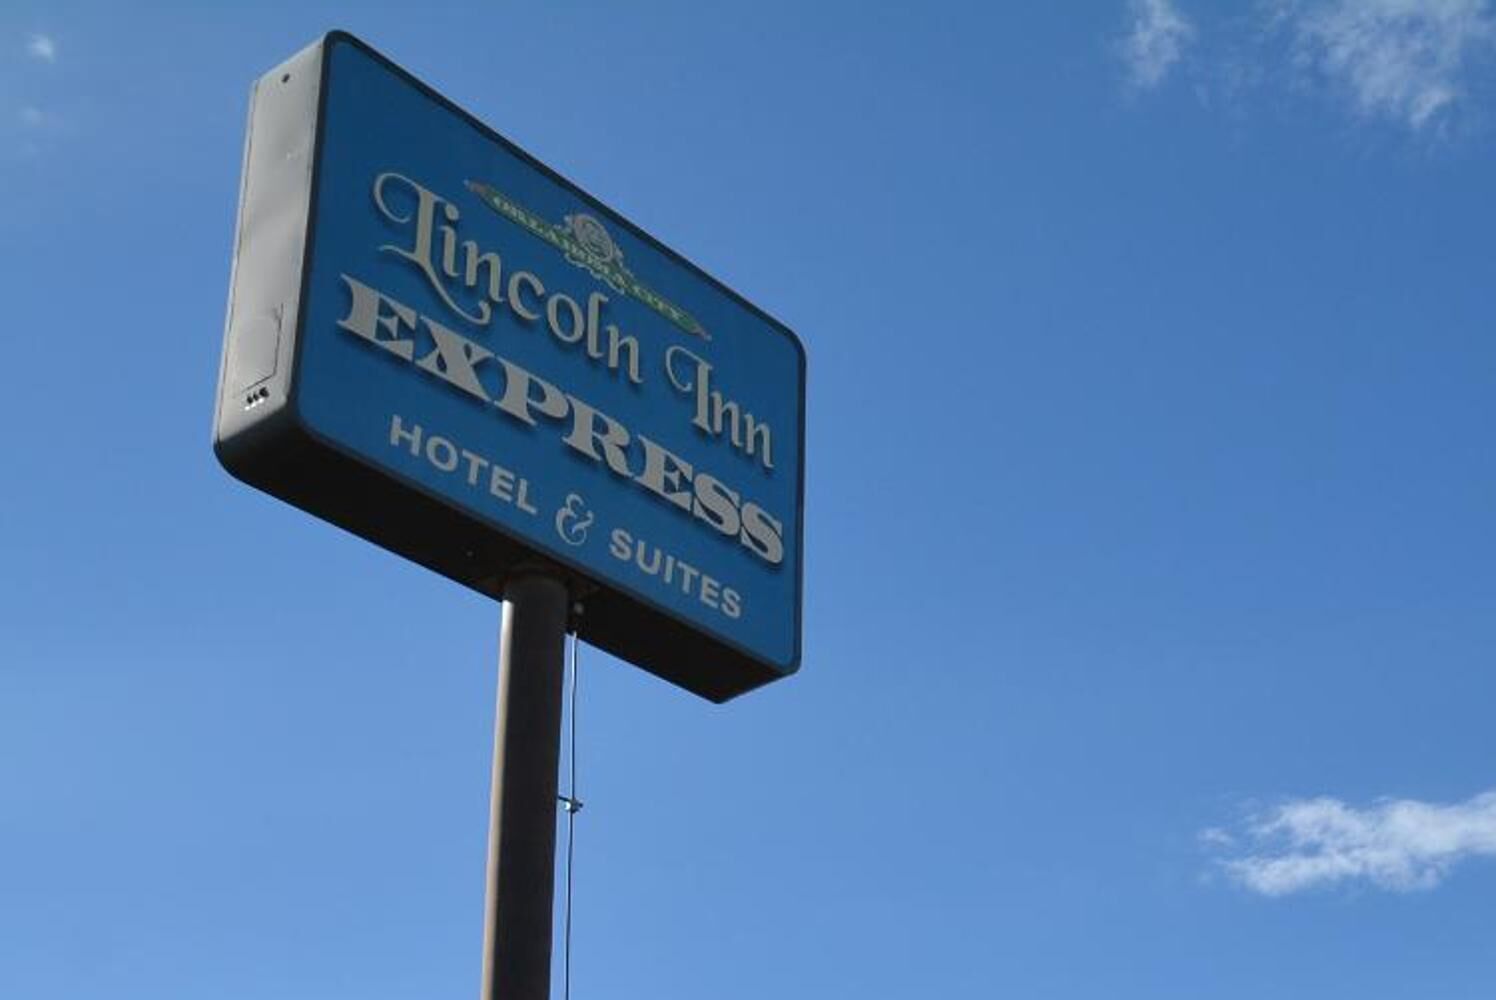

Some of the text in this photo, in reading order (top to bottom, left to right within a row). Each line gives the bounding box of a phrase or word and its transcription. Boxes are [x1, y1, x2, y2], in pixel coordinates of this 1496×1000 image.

[336, 273, 785, 567] EXPRESS
[371, 172, 774, 469] Lincoln Inn
[389, 415, 743, 620] HOTEL & SUITES
